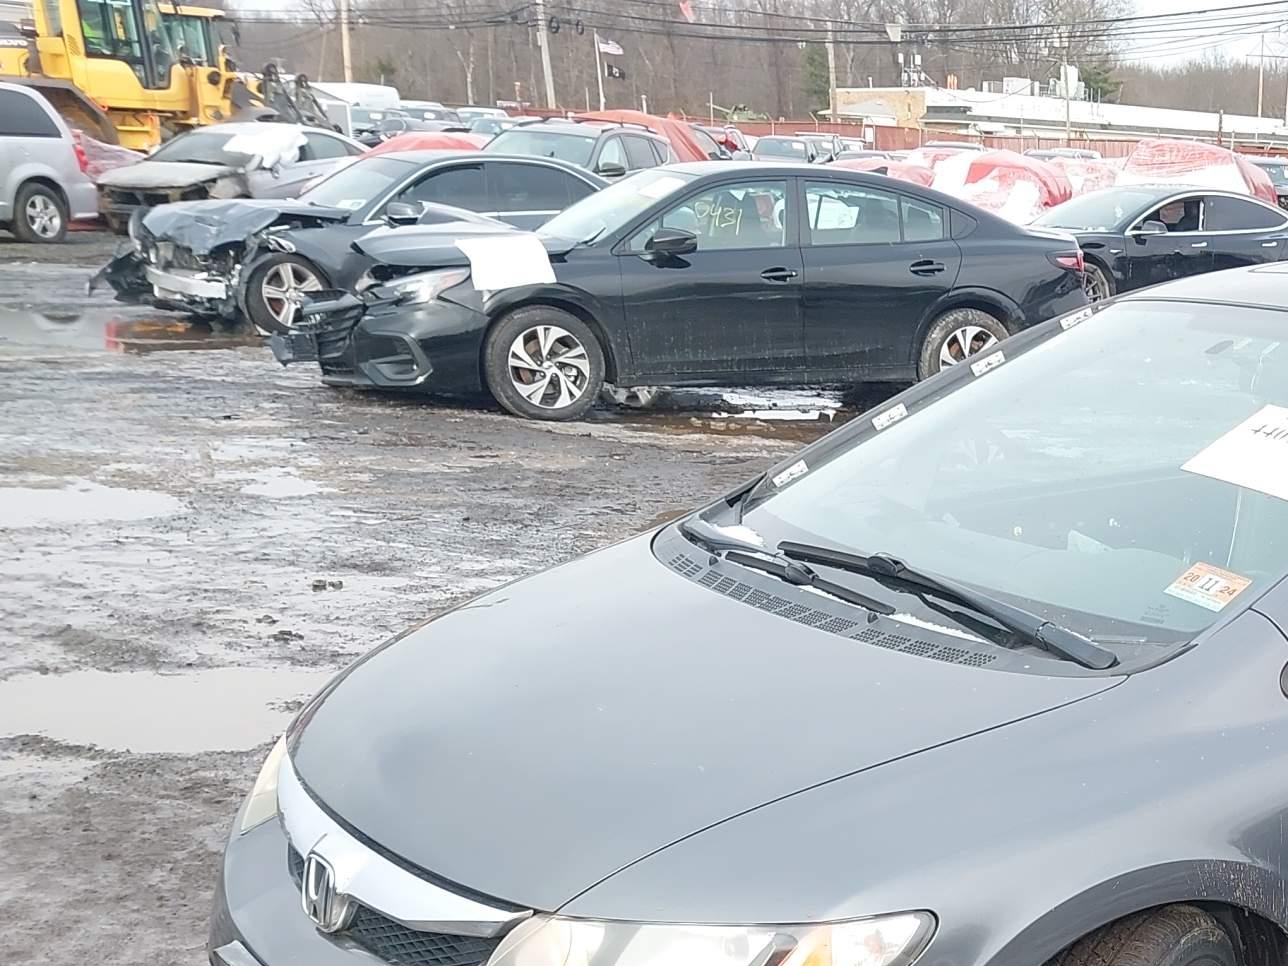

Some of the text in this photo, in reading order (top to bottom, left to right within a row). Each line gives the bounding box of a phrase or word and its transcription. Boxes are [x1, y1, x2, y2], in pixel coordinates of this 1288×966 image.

[1183, 572, 1201, 583] 20
[1198, 577, 1219, 592] 11
[1219, 586, 1237, 597] 24
